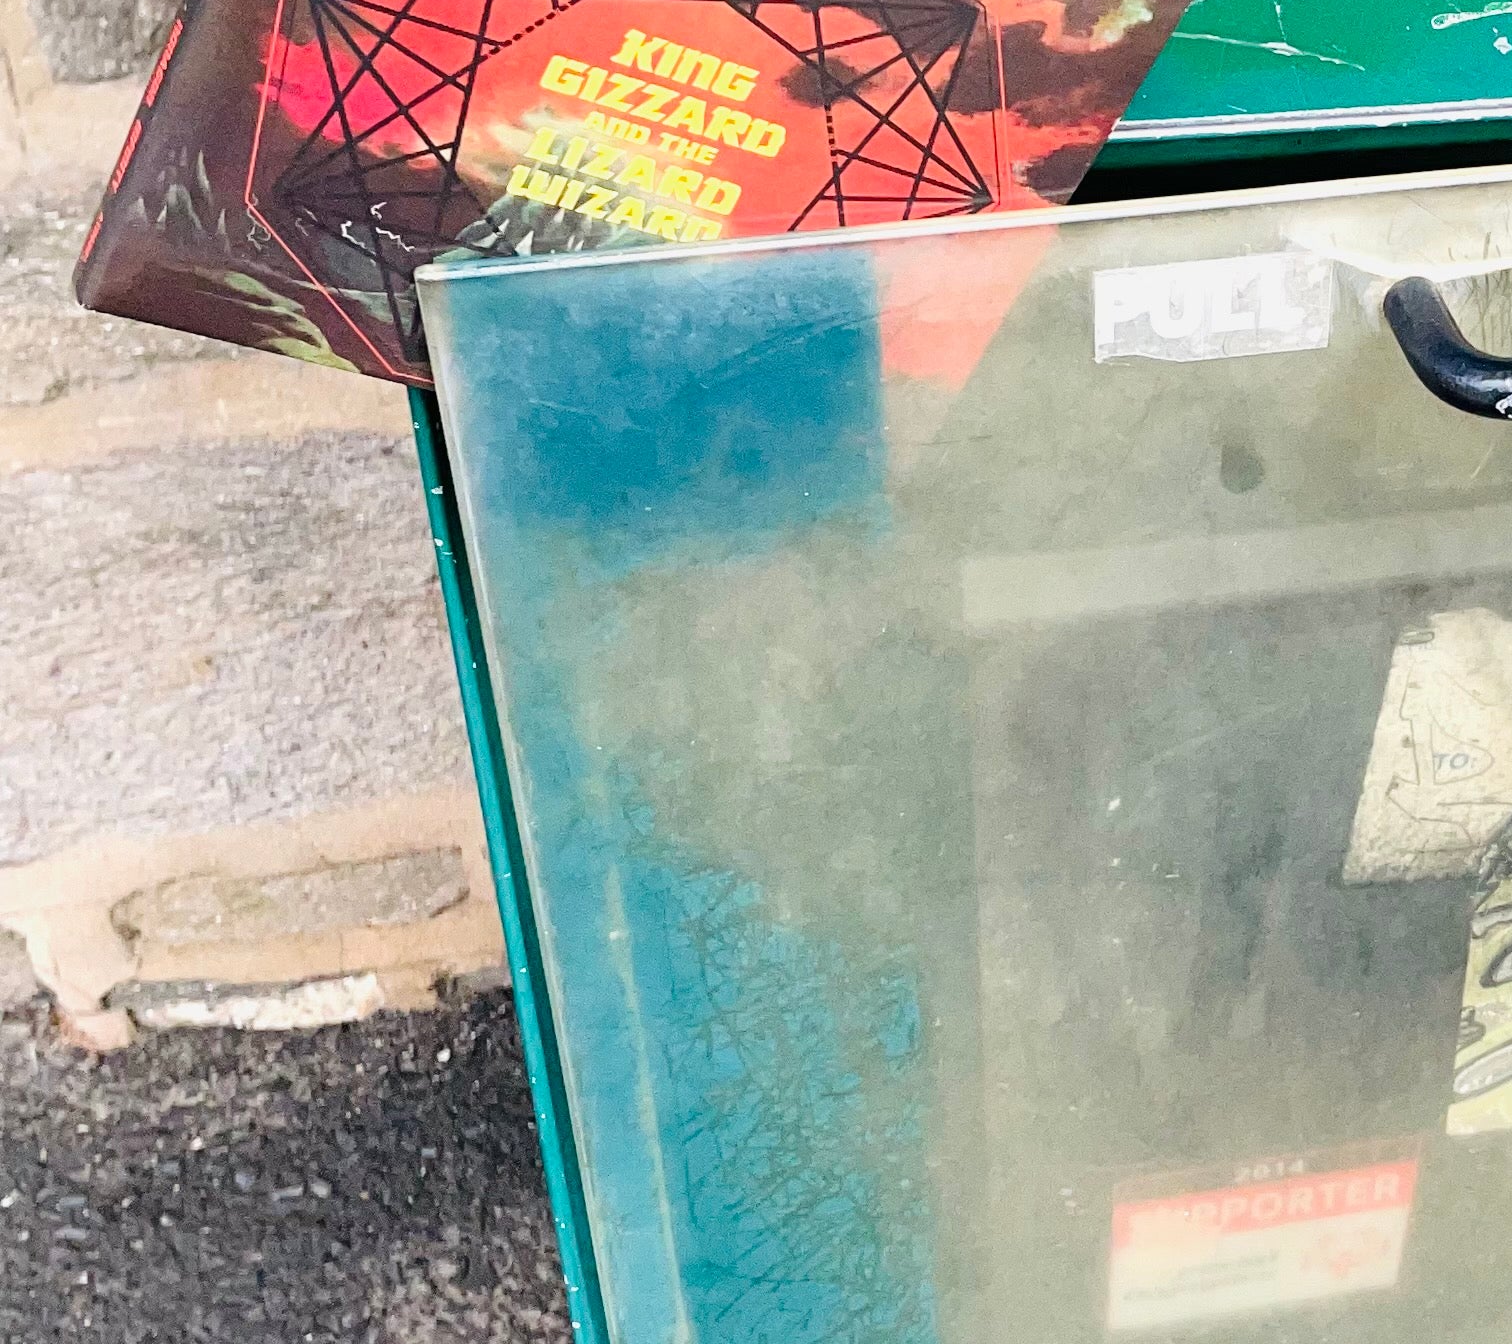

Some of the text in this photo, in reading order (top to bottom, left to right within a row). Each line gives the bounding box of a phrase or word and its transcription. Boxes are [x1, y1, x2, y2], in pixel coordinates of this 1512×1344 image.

[539, 54, 788, 159] GIZZARD
[609, 28, 761, 103] KING
[523, 126, 743, 216] LIZARD
[584, 110, 720, 166] AND THE
[505, 163, 724, 243] WIZARD
[1097, 258, 1307, 348] PULL
